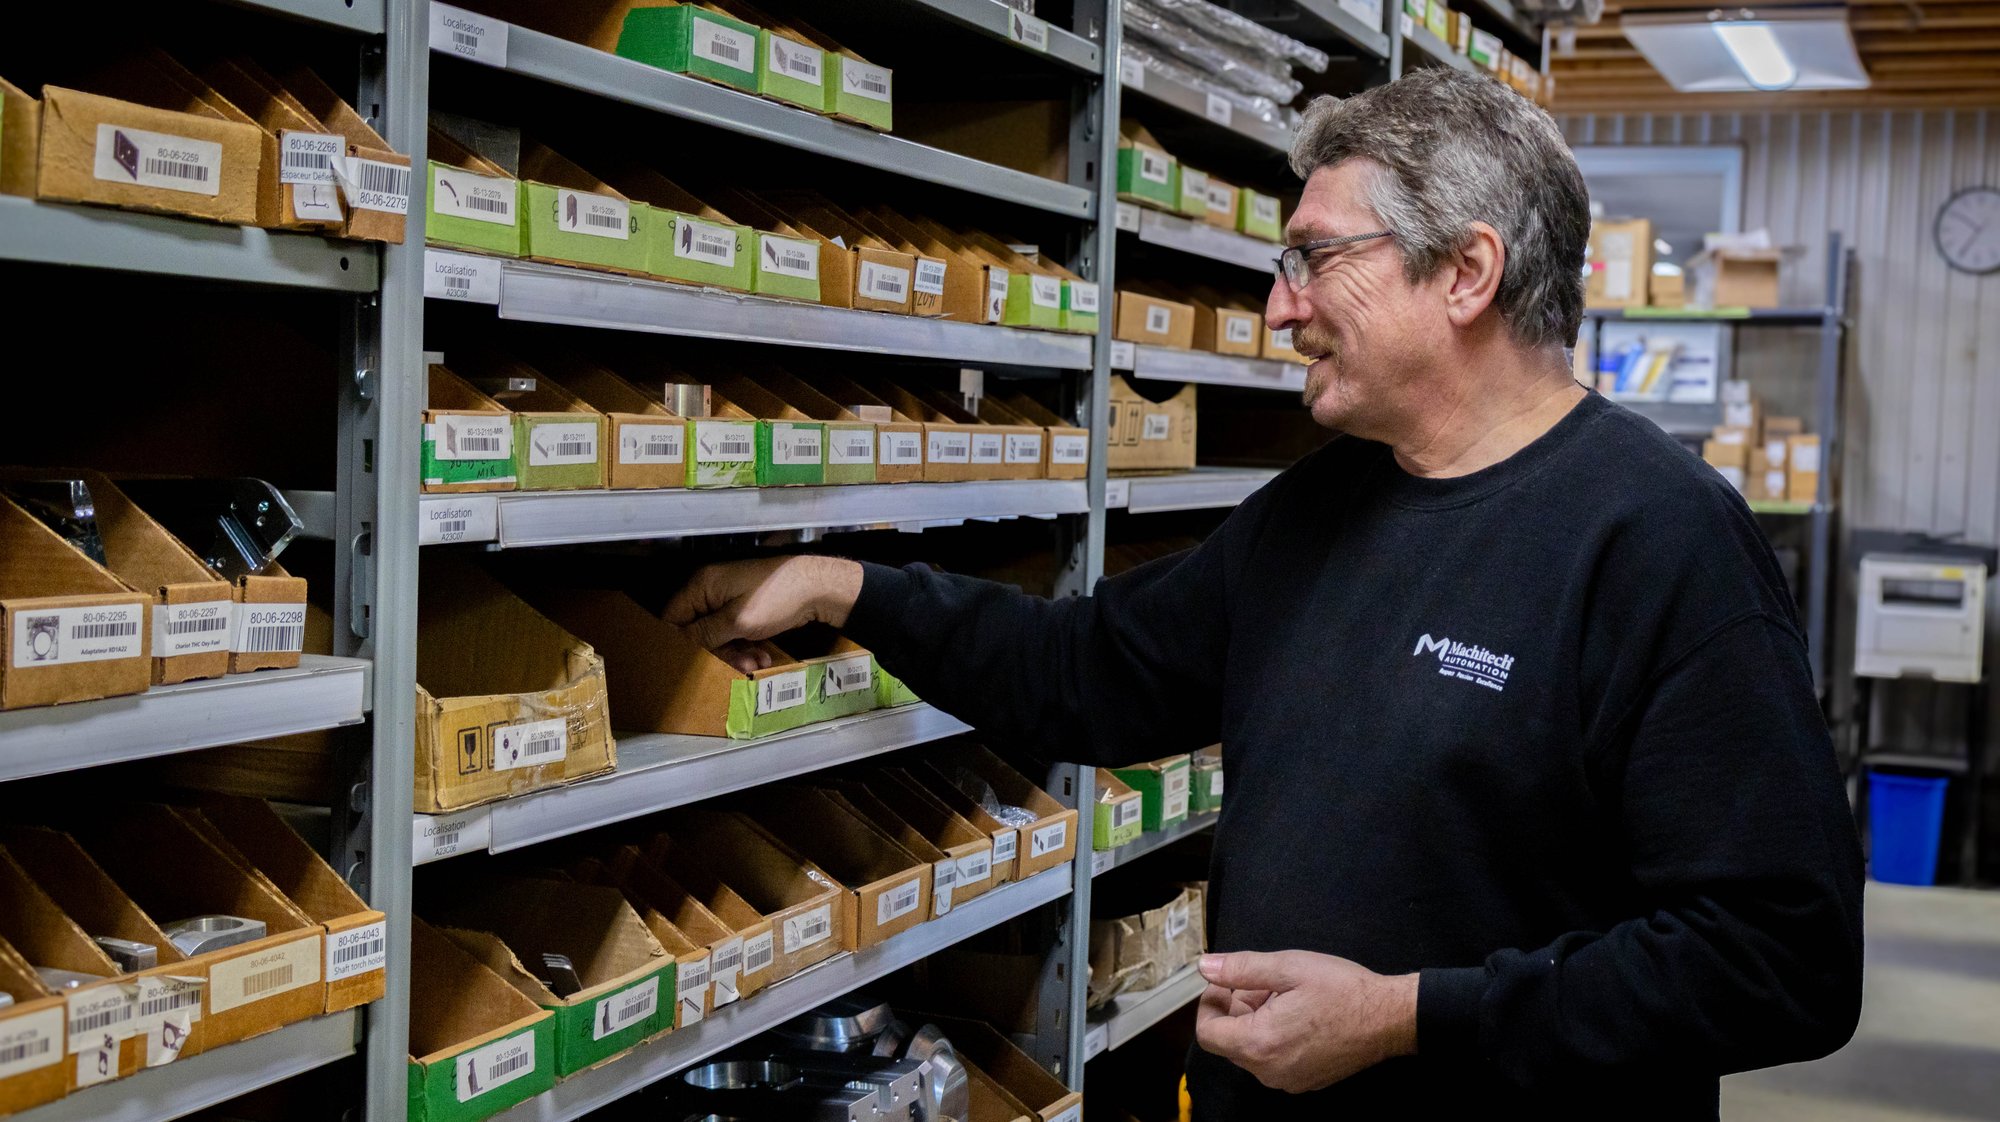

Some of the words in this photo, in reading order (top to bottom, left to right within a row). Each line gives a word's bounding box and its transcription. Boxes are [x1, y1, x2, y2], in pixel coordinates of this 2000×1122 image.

[443, 15, 485, 37] Localisation
[290, 139, 337, 153] 80-06-2266
[158, 147, 200, 164] 80-06-2259
[281, 170, 312, 182] Espaceur
[360, 192, 407, 210] 80-06-2279
[435, 261, 477, 277] Localisation
[446, 287, 468, 298] A23C08
[476, 464, 497, 479] MIR
[430, 508, 473, 521] Localisation
[441, 532, 464, 542] A23C07
[82, 610, 128, 623] 80-06-2295
[178, 606, 218, 621] 80-06-2297
[250, 610, 303, 625] 80-06-2298
[1447, 641, 1511, 671] Machitech
[1444, 656, 1509, 680] AUTOMATION
[423, 819, 466, 838] Localisation
[435, 844, 457, 856] A23C06
[337, 927, 380, 947] 80-06-4043
[250, 951, 286, 970] 80-06-4042
[334, 963, 350, 976] Shaft
[350, 959, 368, 973] torch
